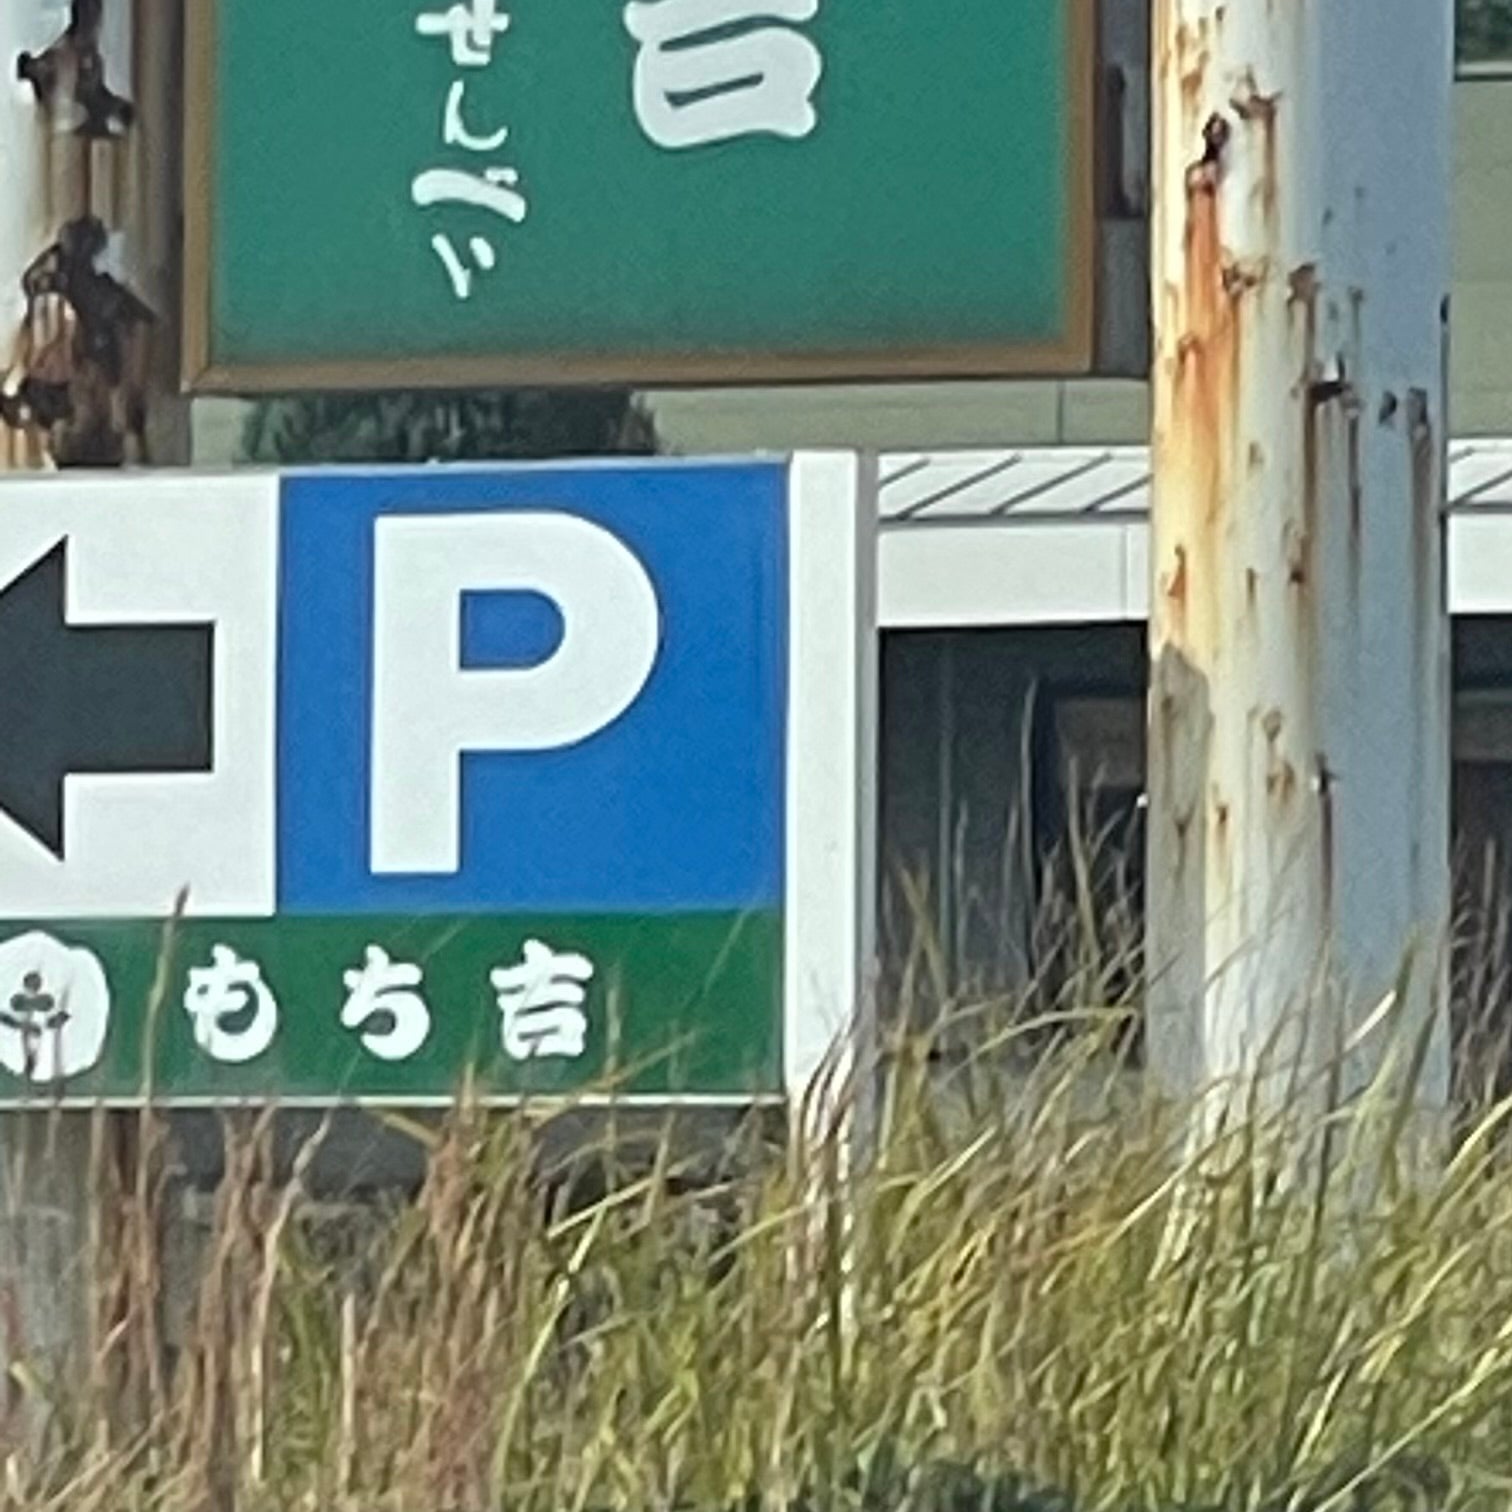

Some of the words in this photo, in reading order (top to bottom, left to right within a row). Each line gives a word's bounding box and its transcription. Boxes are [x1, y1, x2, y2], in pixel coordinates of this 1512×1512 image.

[370, 510, 660, 875] P
[184, 939, 594, 1062] もち吉
